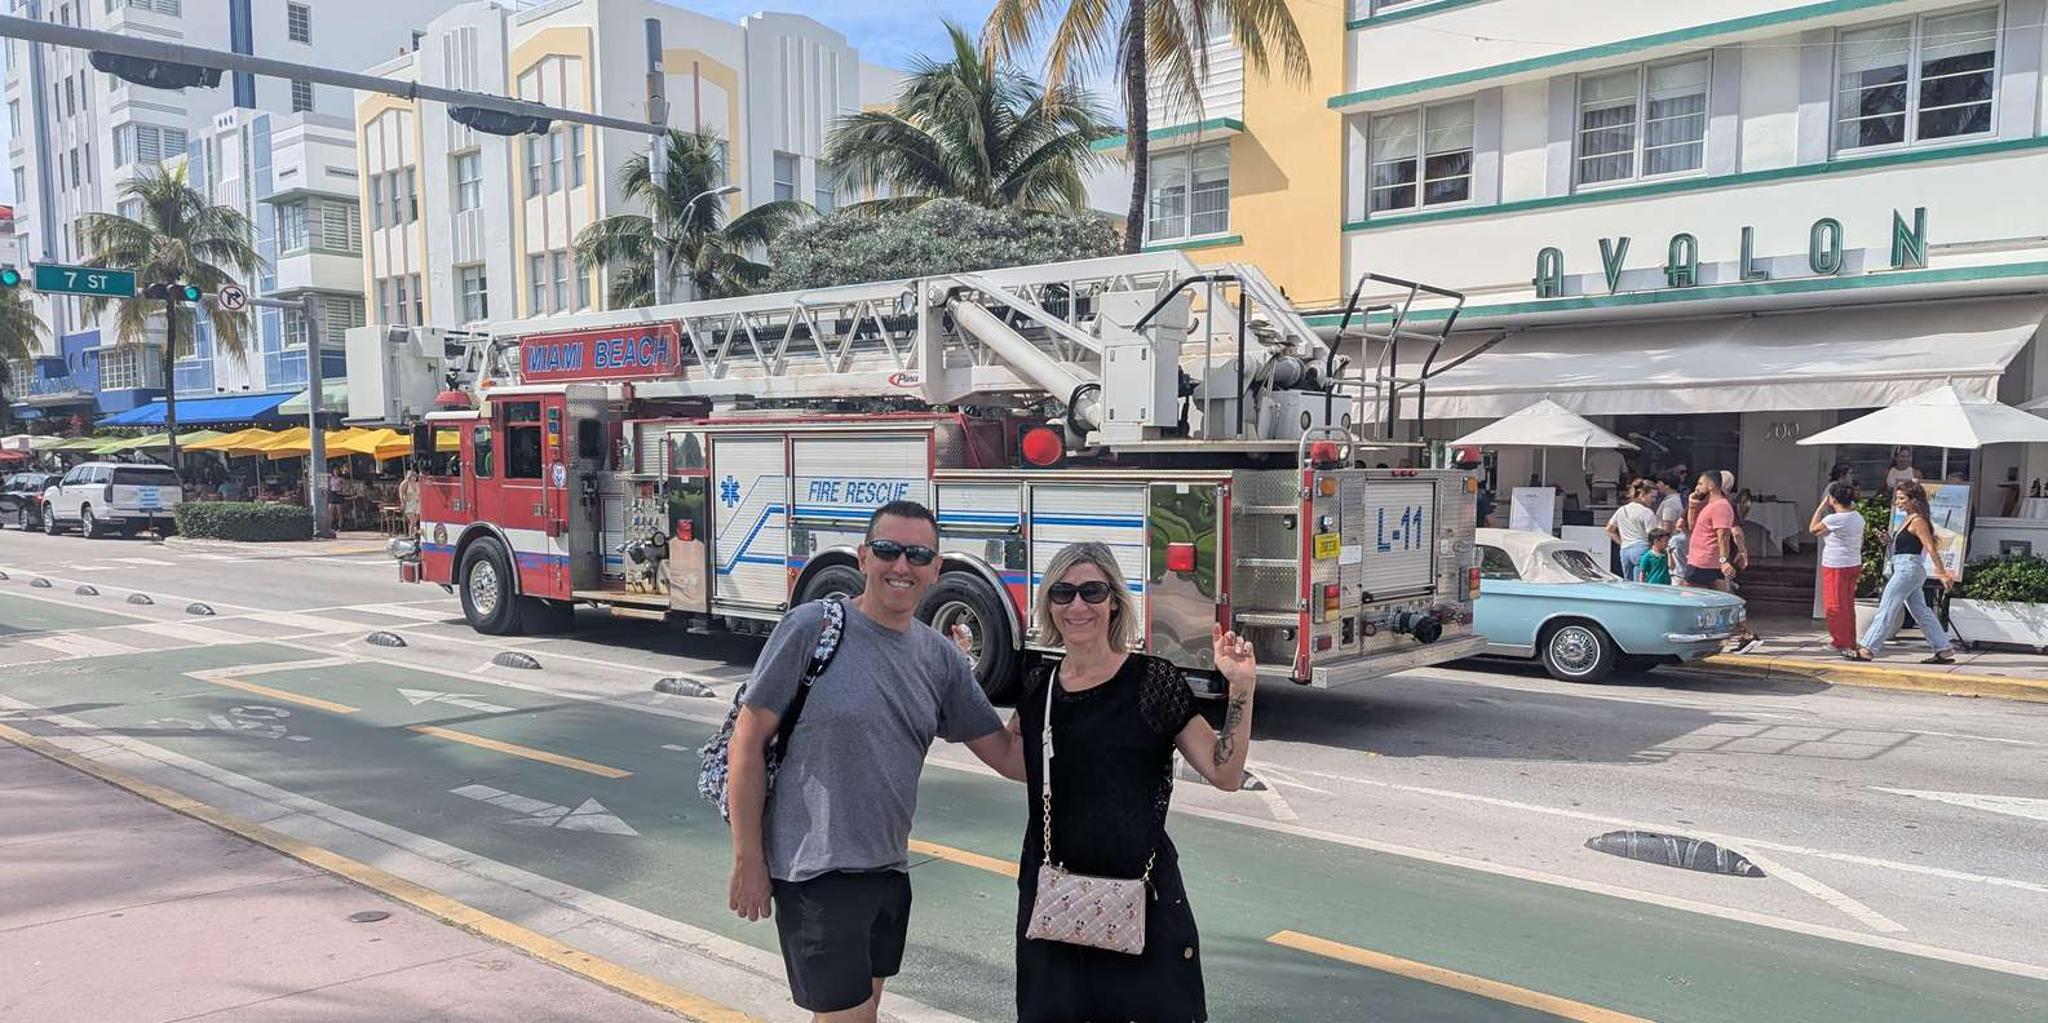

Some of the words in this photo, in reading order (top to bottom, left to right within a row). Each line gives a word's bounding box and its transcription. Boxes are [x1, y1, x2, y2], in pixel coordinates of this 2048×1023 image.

[1532, 206, 1928, 298] AVALON
[63, 271, 77, 289] 7
[87, 274, 108, 290] ST
[527, 341, 584, 373] MIAMI
[593, 334, 670, 369] BEACH
[808, 480, 841, 502] FIRE
[845, 481, 909, 503] RESCUE
[1376, 505, 1423, 553] L-11
